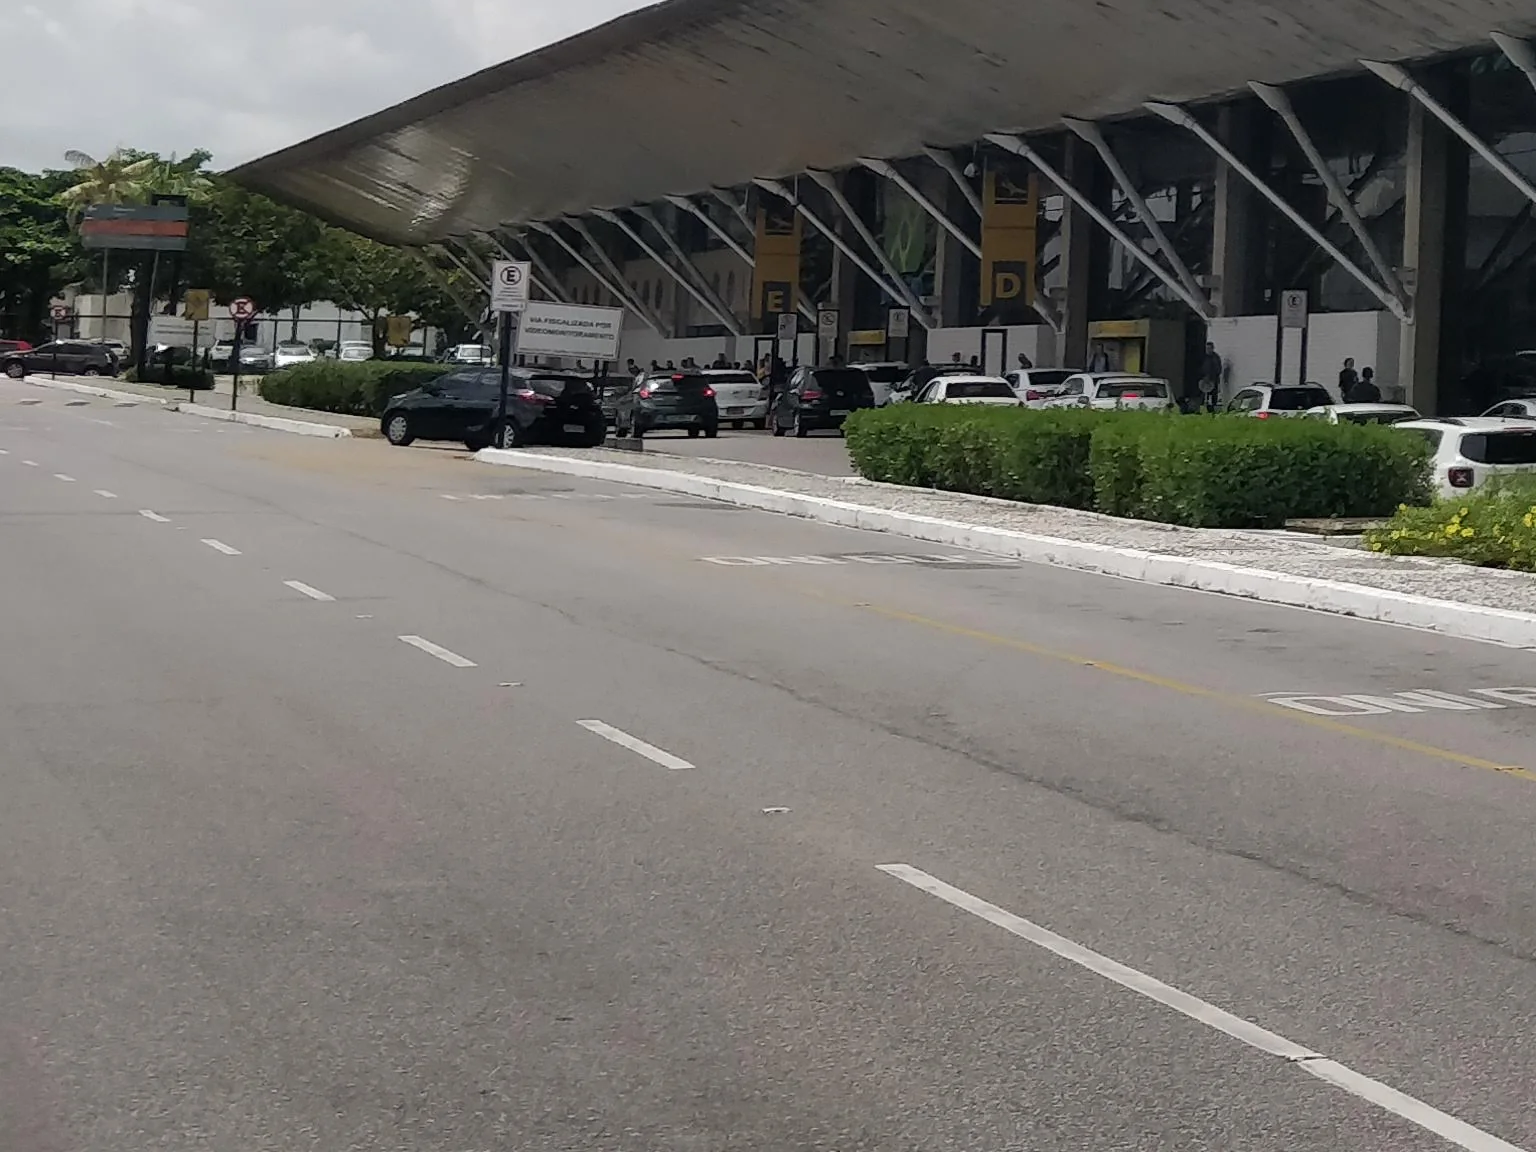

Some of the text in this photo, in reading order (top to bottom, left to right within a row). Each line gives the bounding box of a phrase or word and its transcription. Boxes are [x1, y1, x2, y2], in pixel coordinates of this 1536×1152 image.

[506, 270, 516, 282] E
[996, 272, 1021, 298] D
[768, 291, 784, 312] E
[544, 318, 594, 328] FISCALIZADA
